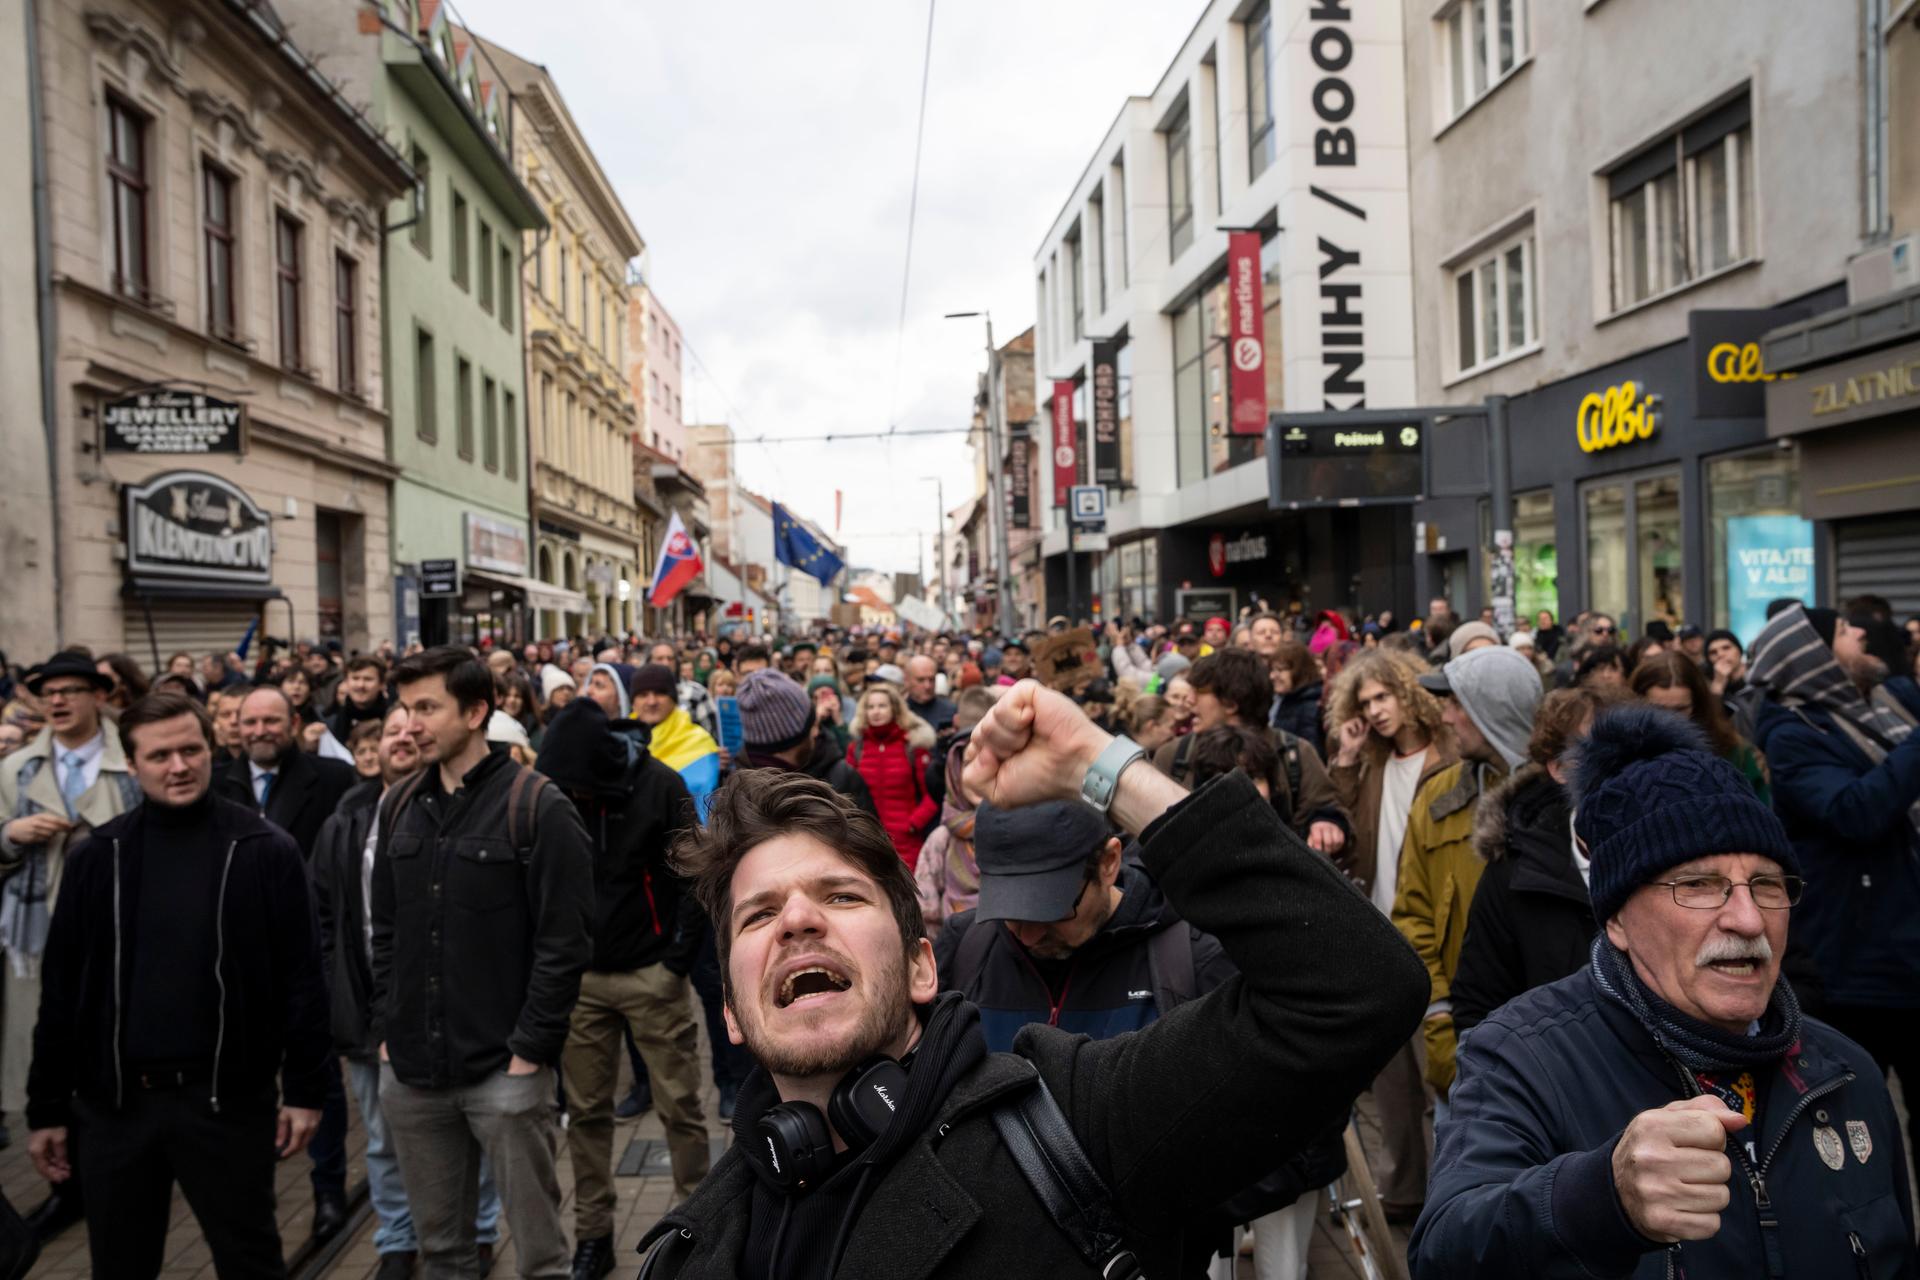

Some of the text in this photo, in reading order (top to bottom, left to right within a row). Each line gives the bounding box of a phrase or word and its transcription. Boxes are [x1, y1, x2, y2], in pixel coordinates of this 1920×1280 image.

[1235, 256, 1254, 335] martinus
[1317, 236, 1366, 410] NIHY
[105, 407, 239, 425] JEWELLERY
[1096, 364, 1115, 443] FOXFORD
[1747, 567, 1762, 584] V
